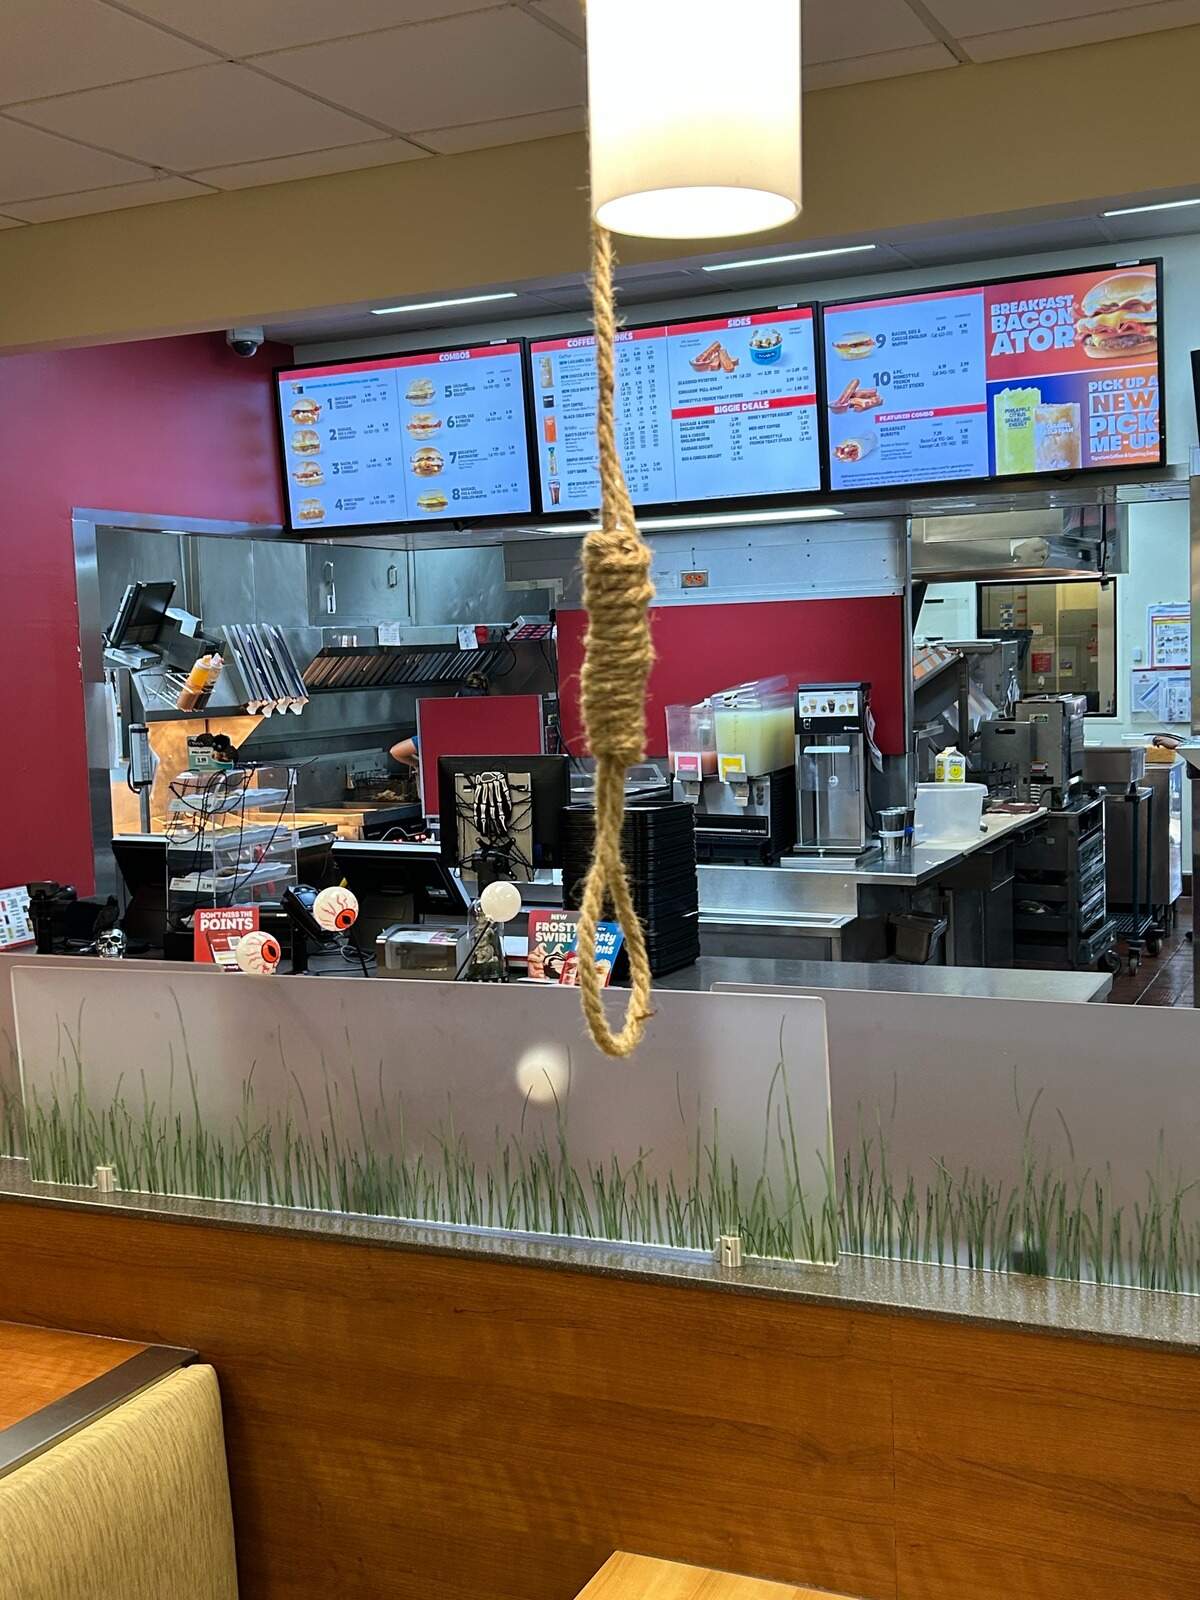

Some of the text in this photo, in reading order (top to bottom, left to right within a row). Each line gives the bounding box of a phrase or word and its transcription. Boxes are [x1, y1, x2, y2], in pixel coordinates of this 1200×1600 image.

[991, 294, 1074, 316] BREAKFAST
[728, 317, 752, 328] SIDES
[991, 307, 1074, 334] BACON
[568, 336, 595, 348] COFFEE
[876, 334, 886, 348] 9
[990, 325, 1075, 357] ATOR
[439, 351, 470, 362] COMBOS
[872, 371, 891, 387] 10
[1088, 376, 1159, 393] PICK UP A
[444, 384, 452, 398] 5
[327, 398, 333, 410] 1
[714, 401, 770, 414] BIGGIE DEALS
[1091, 390, 1155, 414] NEW
[447, 416, 455, 428] 6
[329, 428, 337, 441] 2
[1090, 432, 1160, 454] ME-UP
[449, 452, 457, 464] 7
[332, 462, 340, 474] 3
[452, 488, 460, 500] 8
[334, 498, 343, 511] 4
[240, 910, 253, 918] THE
[200, 918, 254, 932] POINTS
[535, 932, 576, 942] SWIRL
